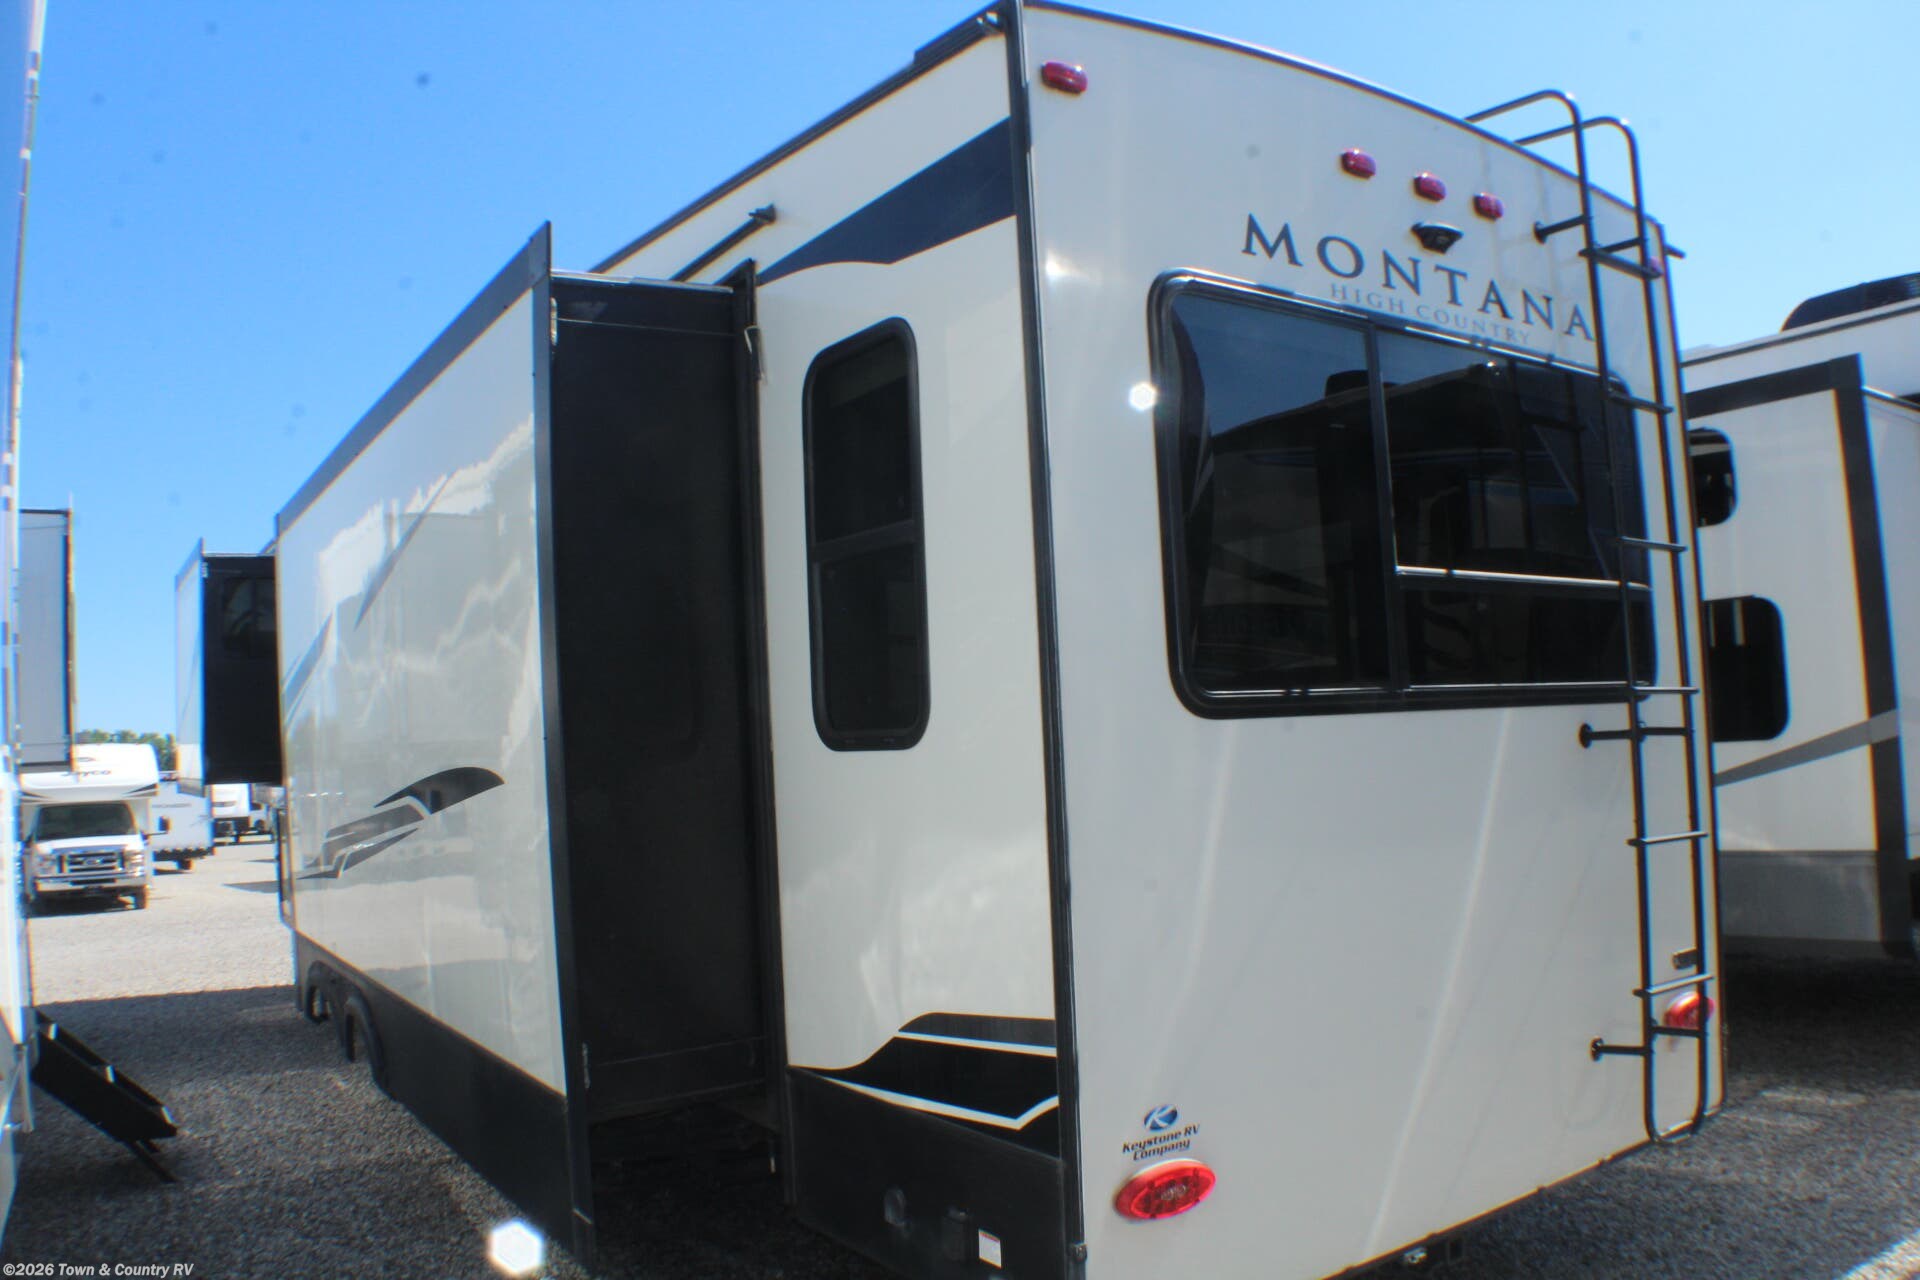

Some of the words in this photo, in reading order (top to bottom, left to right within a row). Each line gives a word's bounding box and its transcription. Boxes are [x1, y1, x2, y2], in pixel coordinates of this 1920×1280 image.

[1241, 213, 1593, 341] MONTANA
[1331, 283, 1404, 314] HIGH
[1416, 305, 1530, 345] COUNTRY
[61, 769, 112, 778] yco
[1122, 1130, 1182, 1153] Keystone
[1183, 1123, 1200, 1137] RV
[1133, 1138, 1191, 1161] Company
